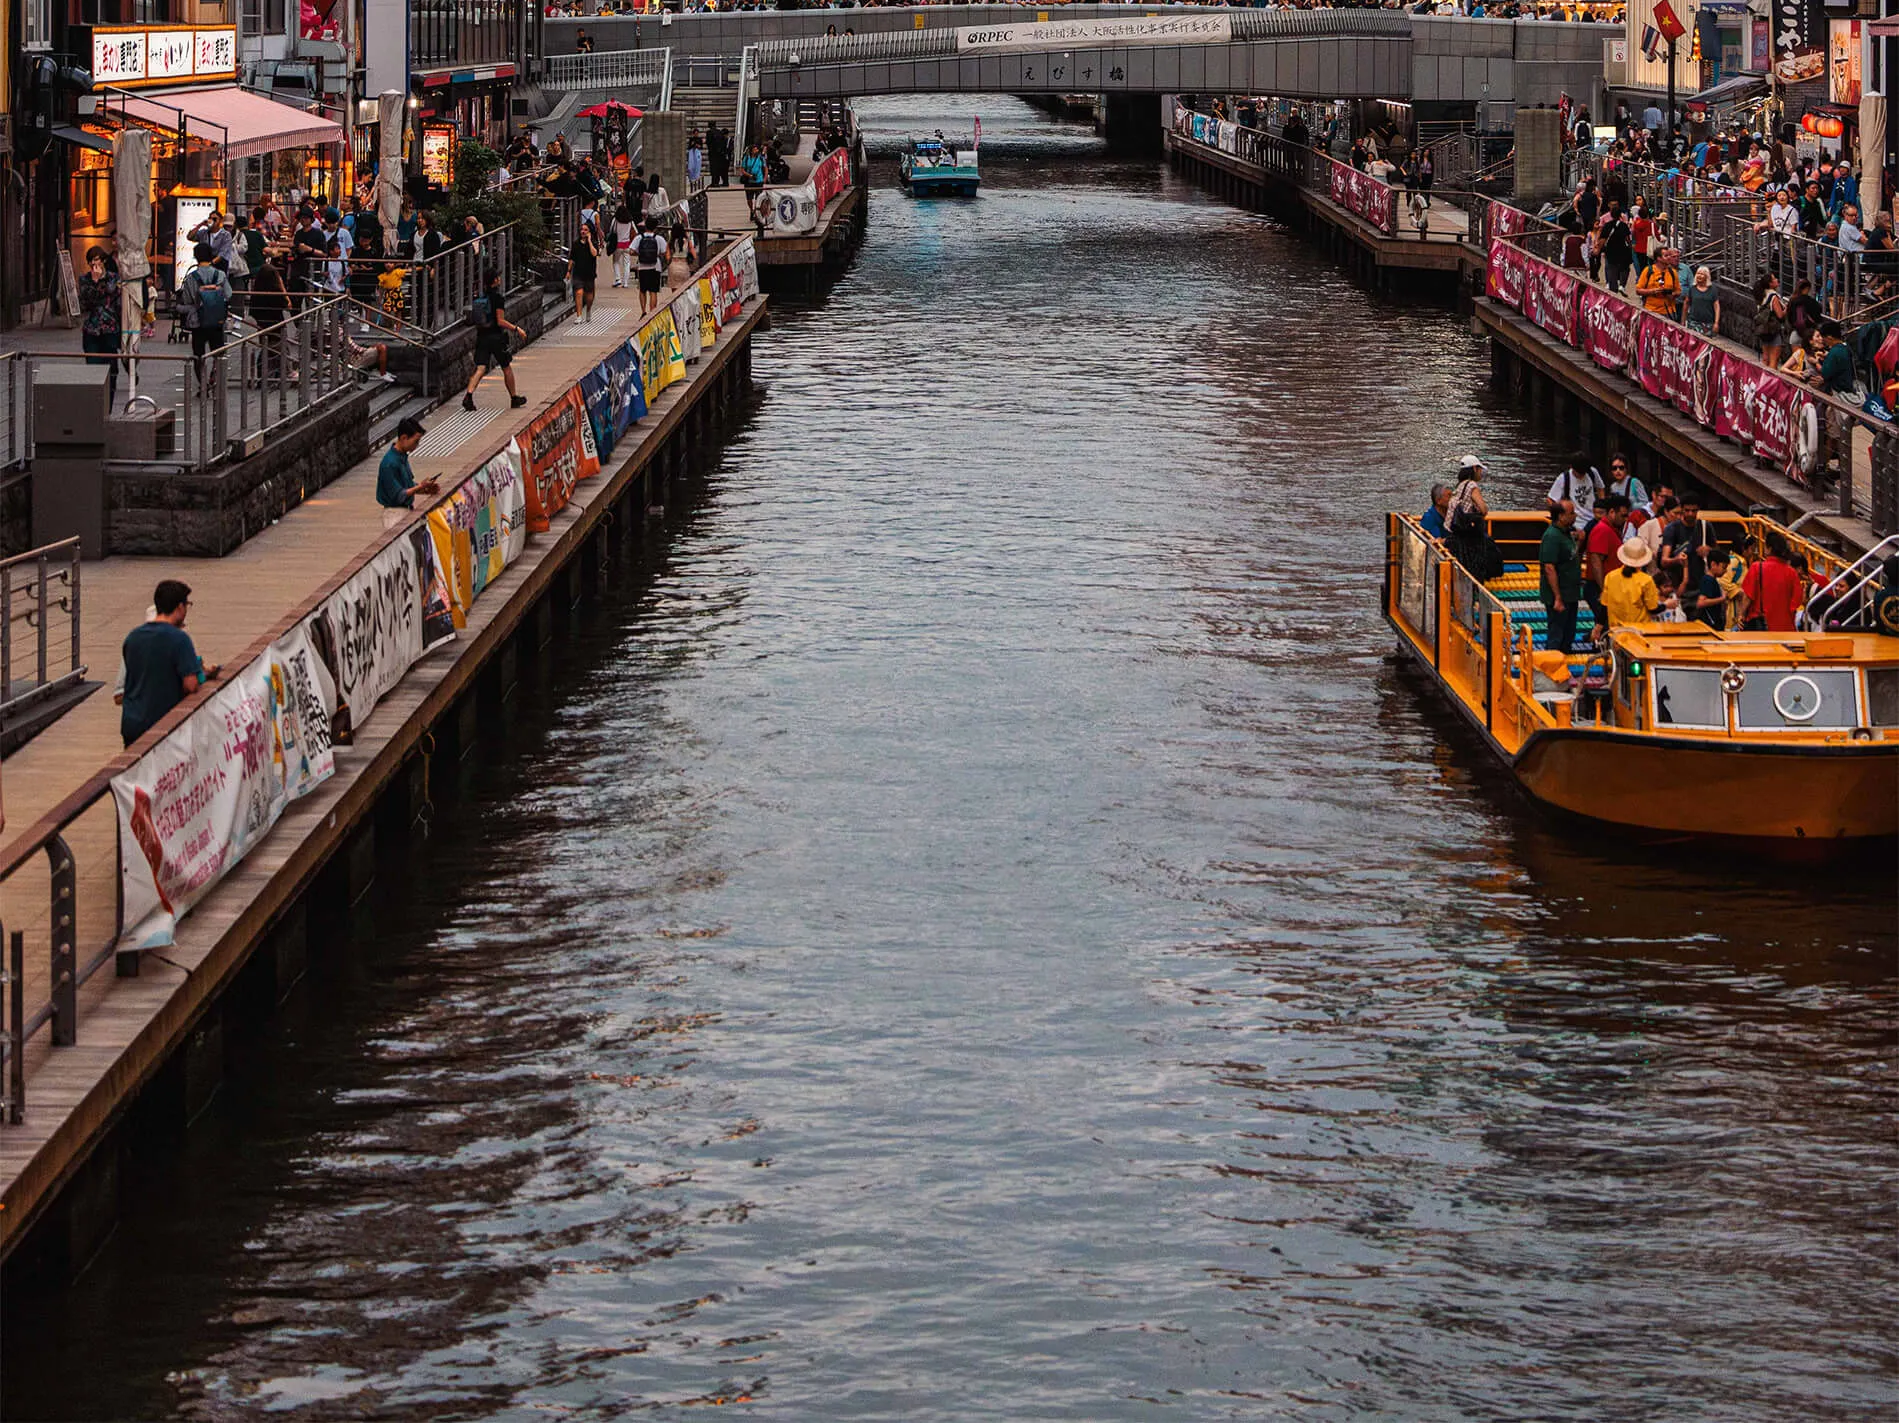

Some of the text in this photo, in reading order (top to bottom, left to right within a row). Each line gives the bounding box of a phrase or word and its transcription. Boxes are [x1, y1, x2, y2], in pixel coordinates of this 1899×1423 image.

[967, 30, 1014, 44] ORPEC
[1022, 27, 1088, 41] 一般社団法人
[1024, 65, 1125, 82] えびす橋
